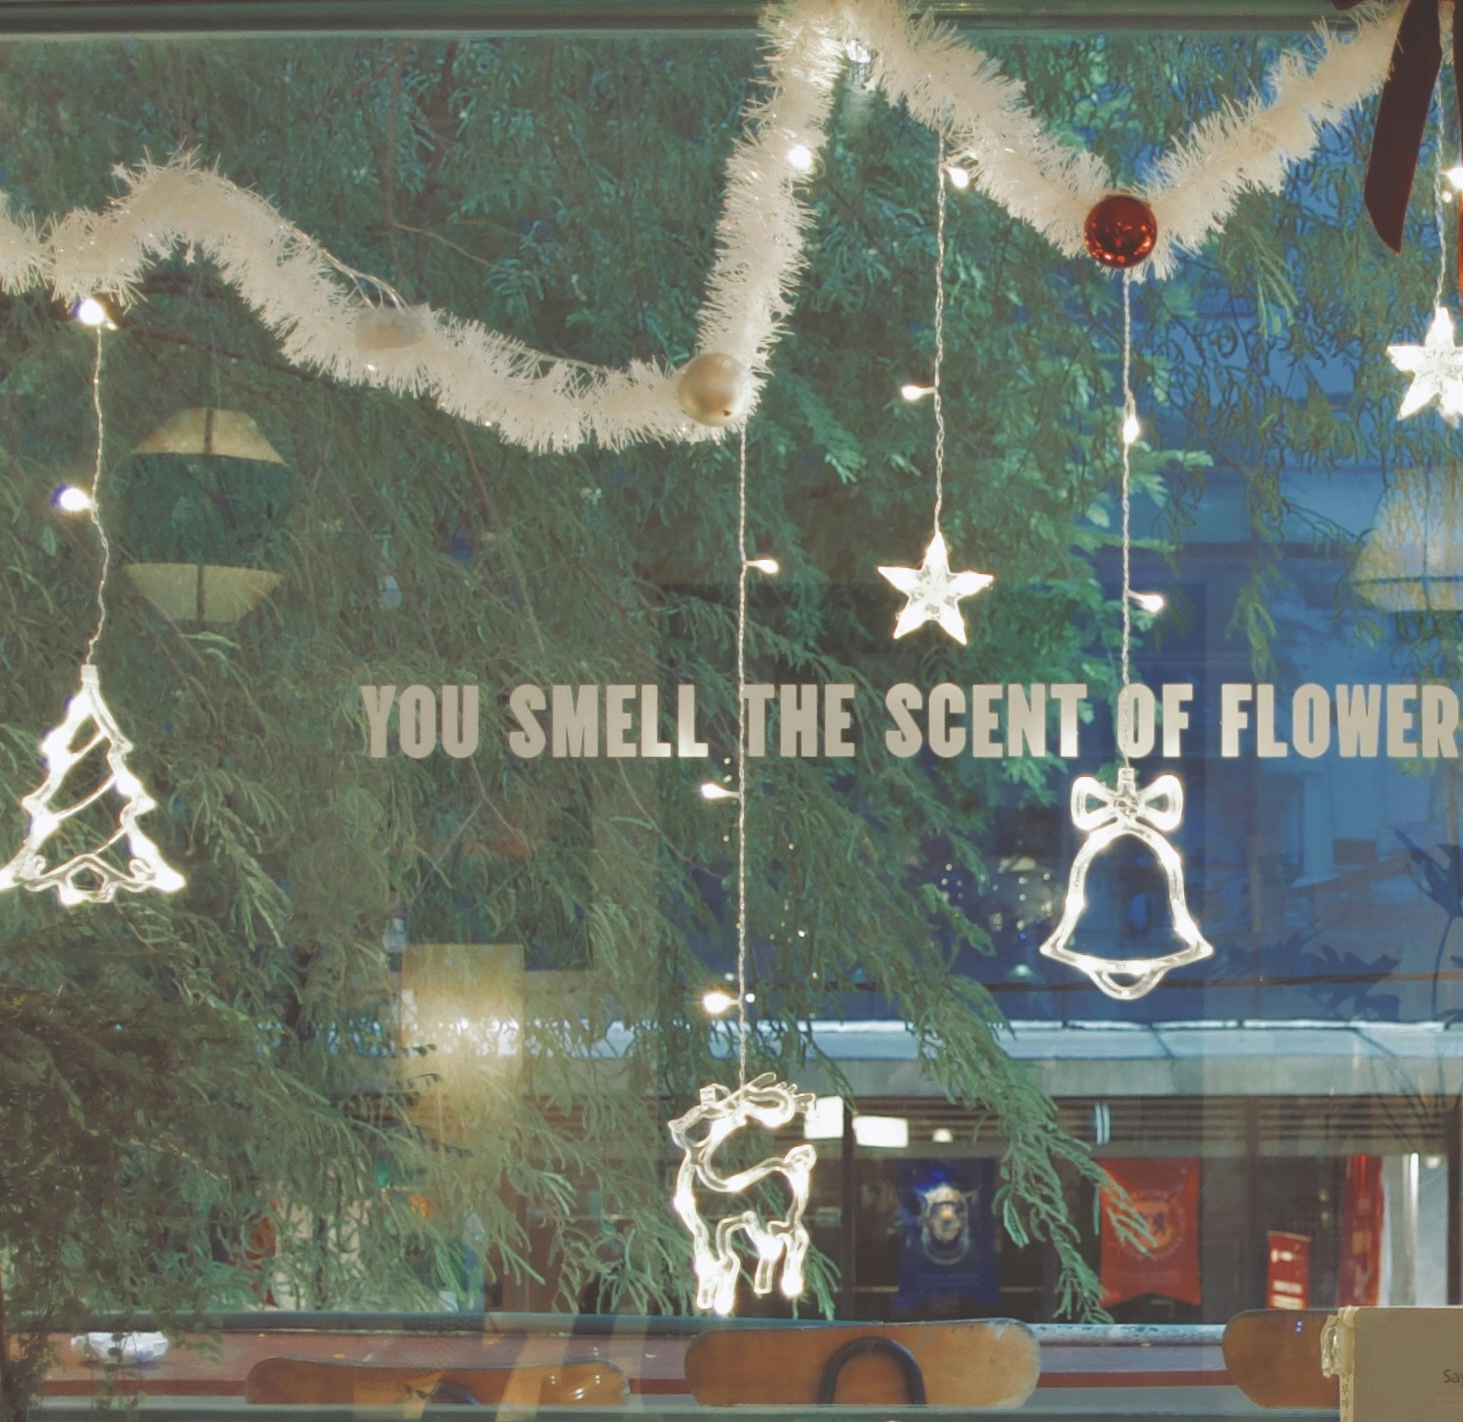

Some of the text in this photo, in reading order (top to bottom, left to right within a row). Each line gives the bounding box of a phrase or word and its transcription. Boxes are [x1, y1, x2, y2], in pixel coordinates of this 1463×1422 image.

[360, 684, 480, 759] YOU
[508, 684, 709, 759] SMELL
[743, 683, 855, 759] THE
[884, 682, 1088, 760] SCENT
[1125, 683, 1194, 759] OF
